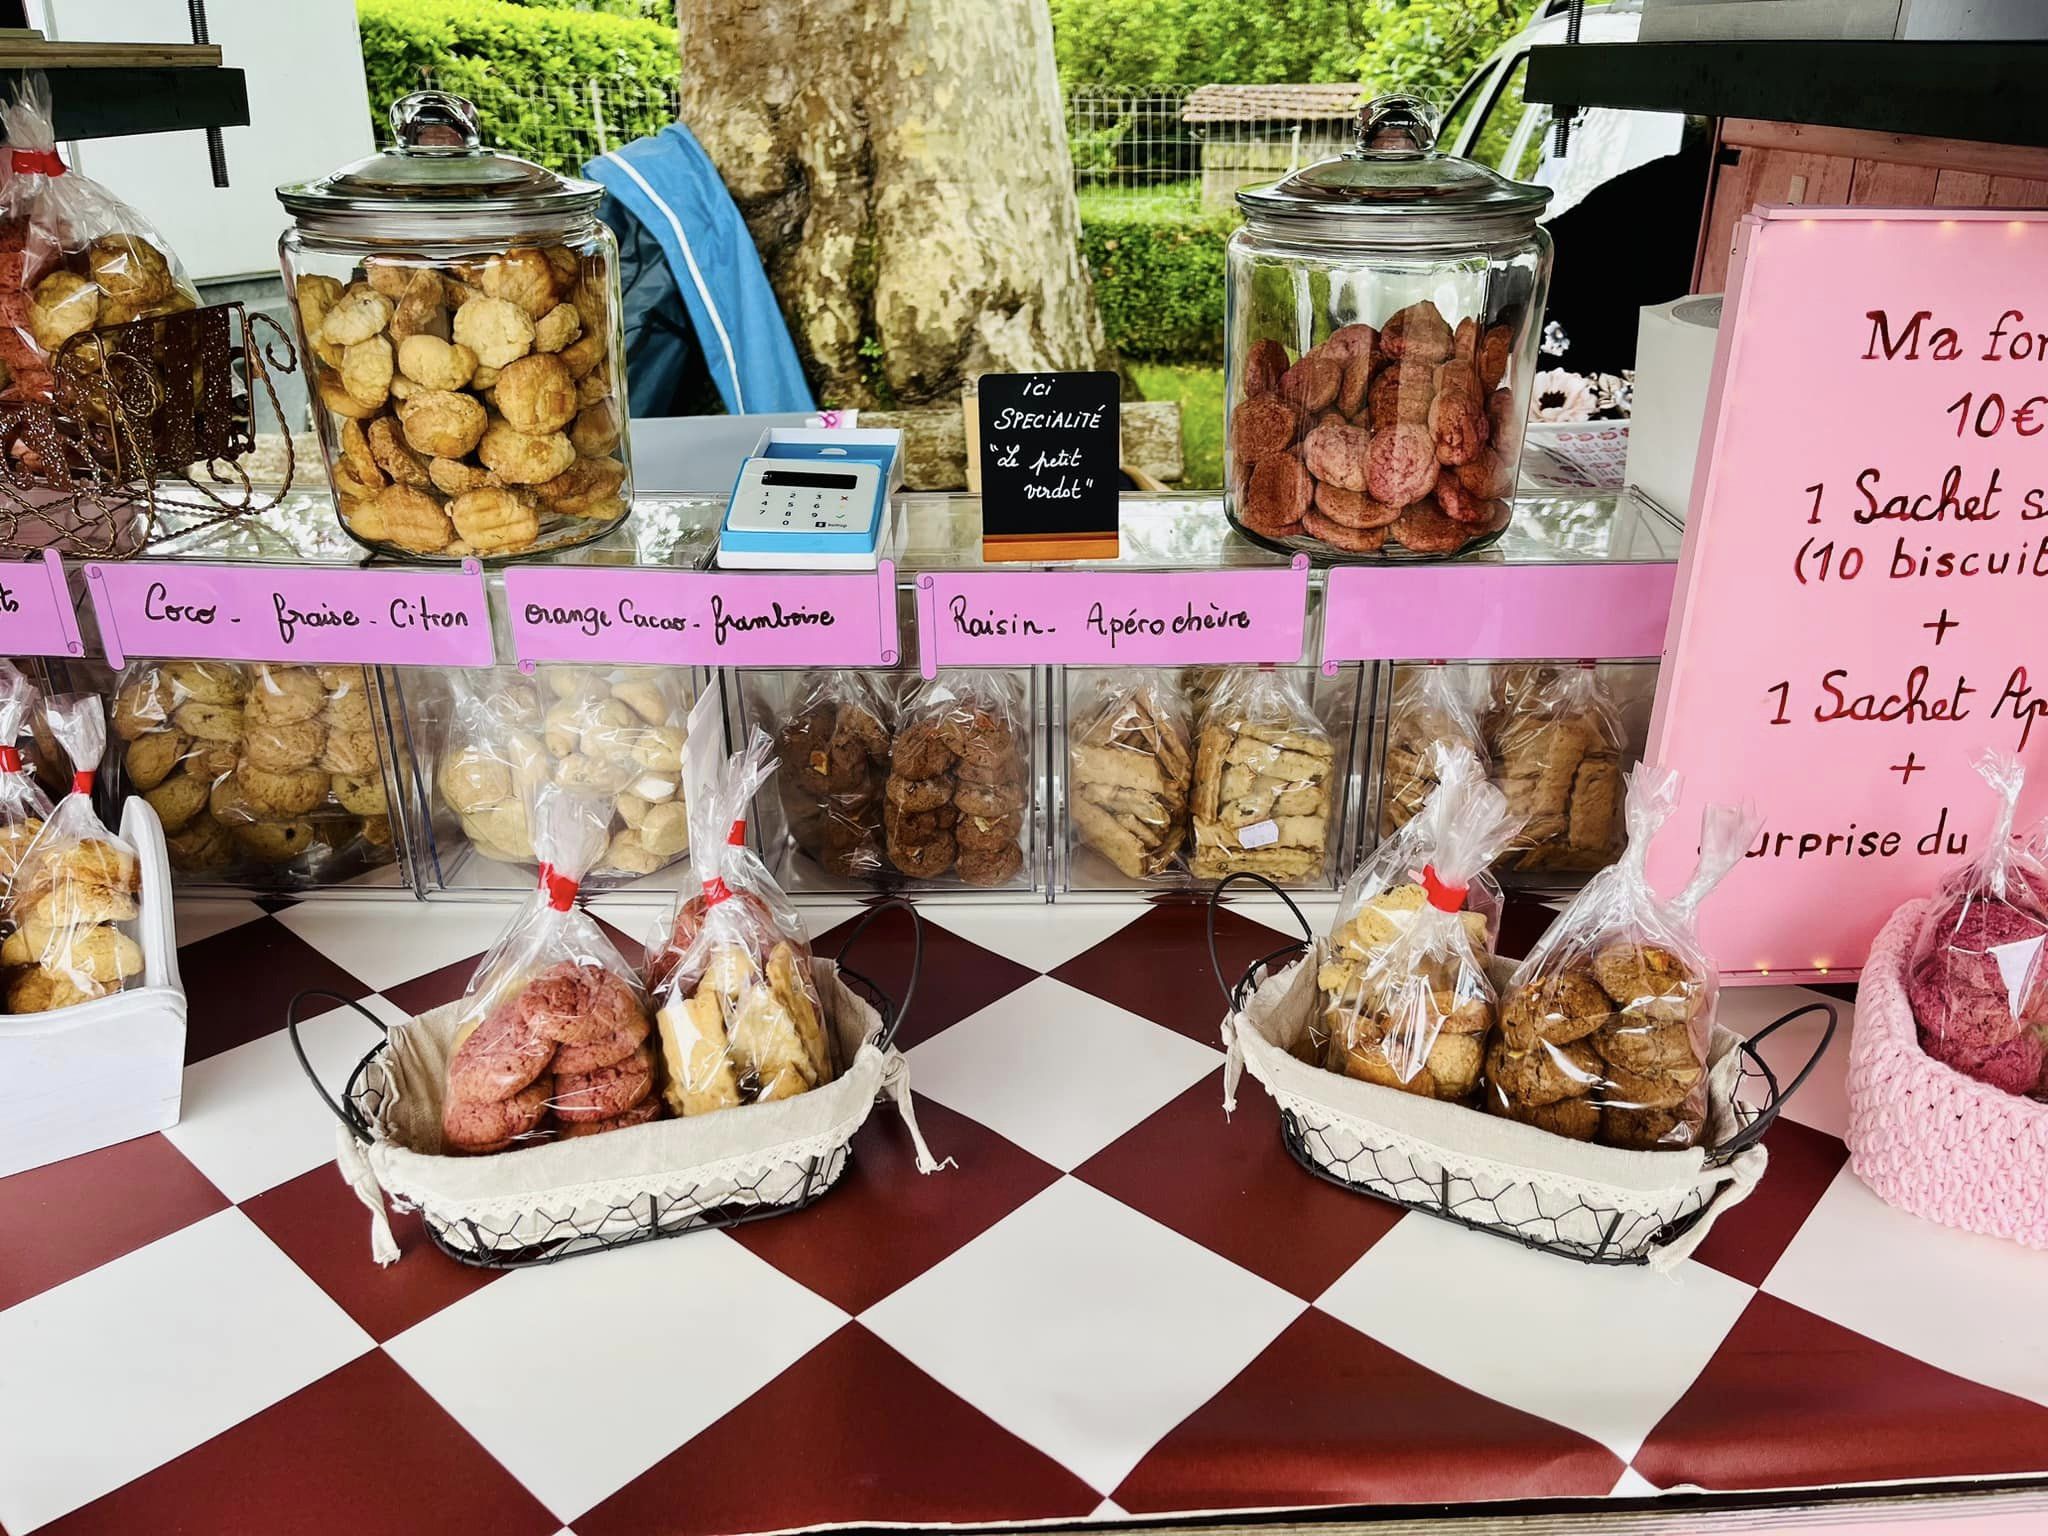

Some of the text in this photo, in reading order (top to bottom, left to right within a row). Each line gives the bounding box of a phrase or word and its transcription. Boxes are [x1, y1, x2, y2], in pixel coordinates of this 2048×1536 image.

[1860, 309, 1963, 361] Ma
[1023, 376, 1056, 396] ici
[1946, 391, 2048, 439] 10€
[1029, 448, 1083, 477] petit
[1805, 482, 1824, 525] 1
[1854, 465, 2003, 525] Sachet
[1793, 536, 1864, 585] (10
[145, 582, 216, 625] Coco
[273, 592, 361, 644] fraise
[390, 595, 469, 631] Citron
[1767, 680, 1791, 725] 1
[1814, 665, 1977, 725] Sachet
[1697, 806, 1969, 860] urprise du
